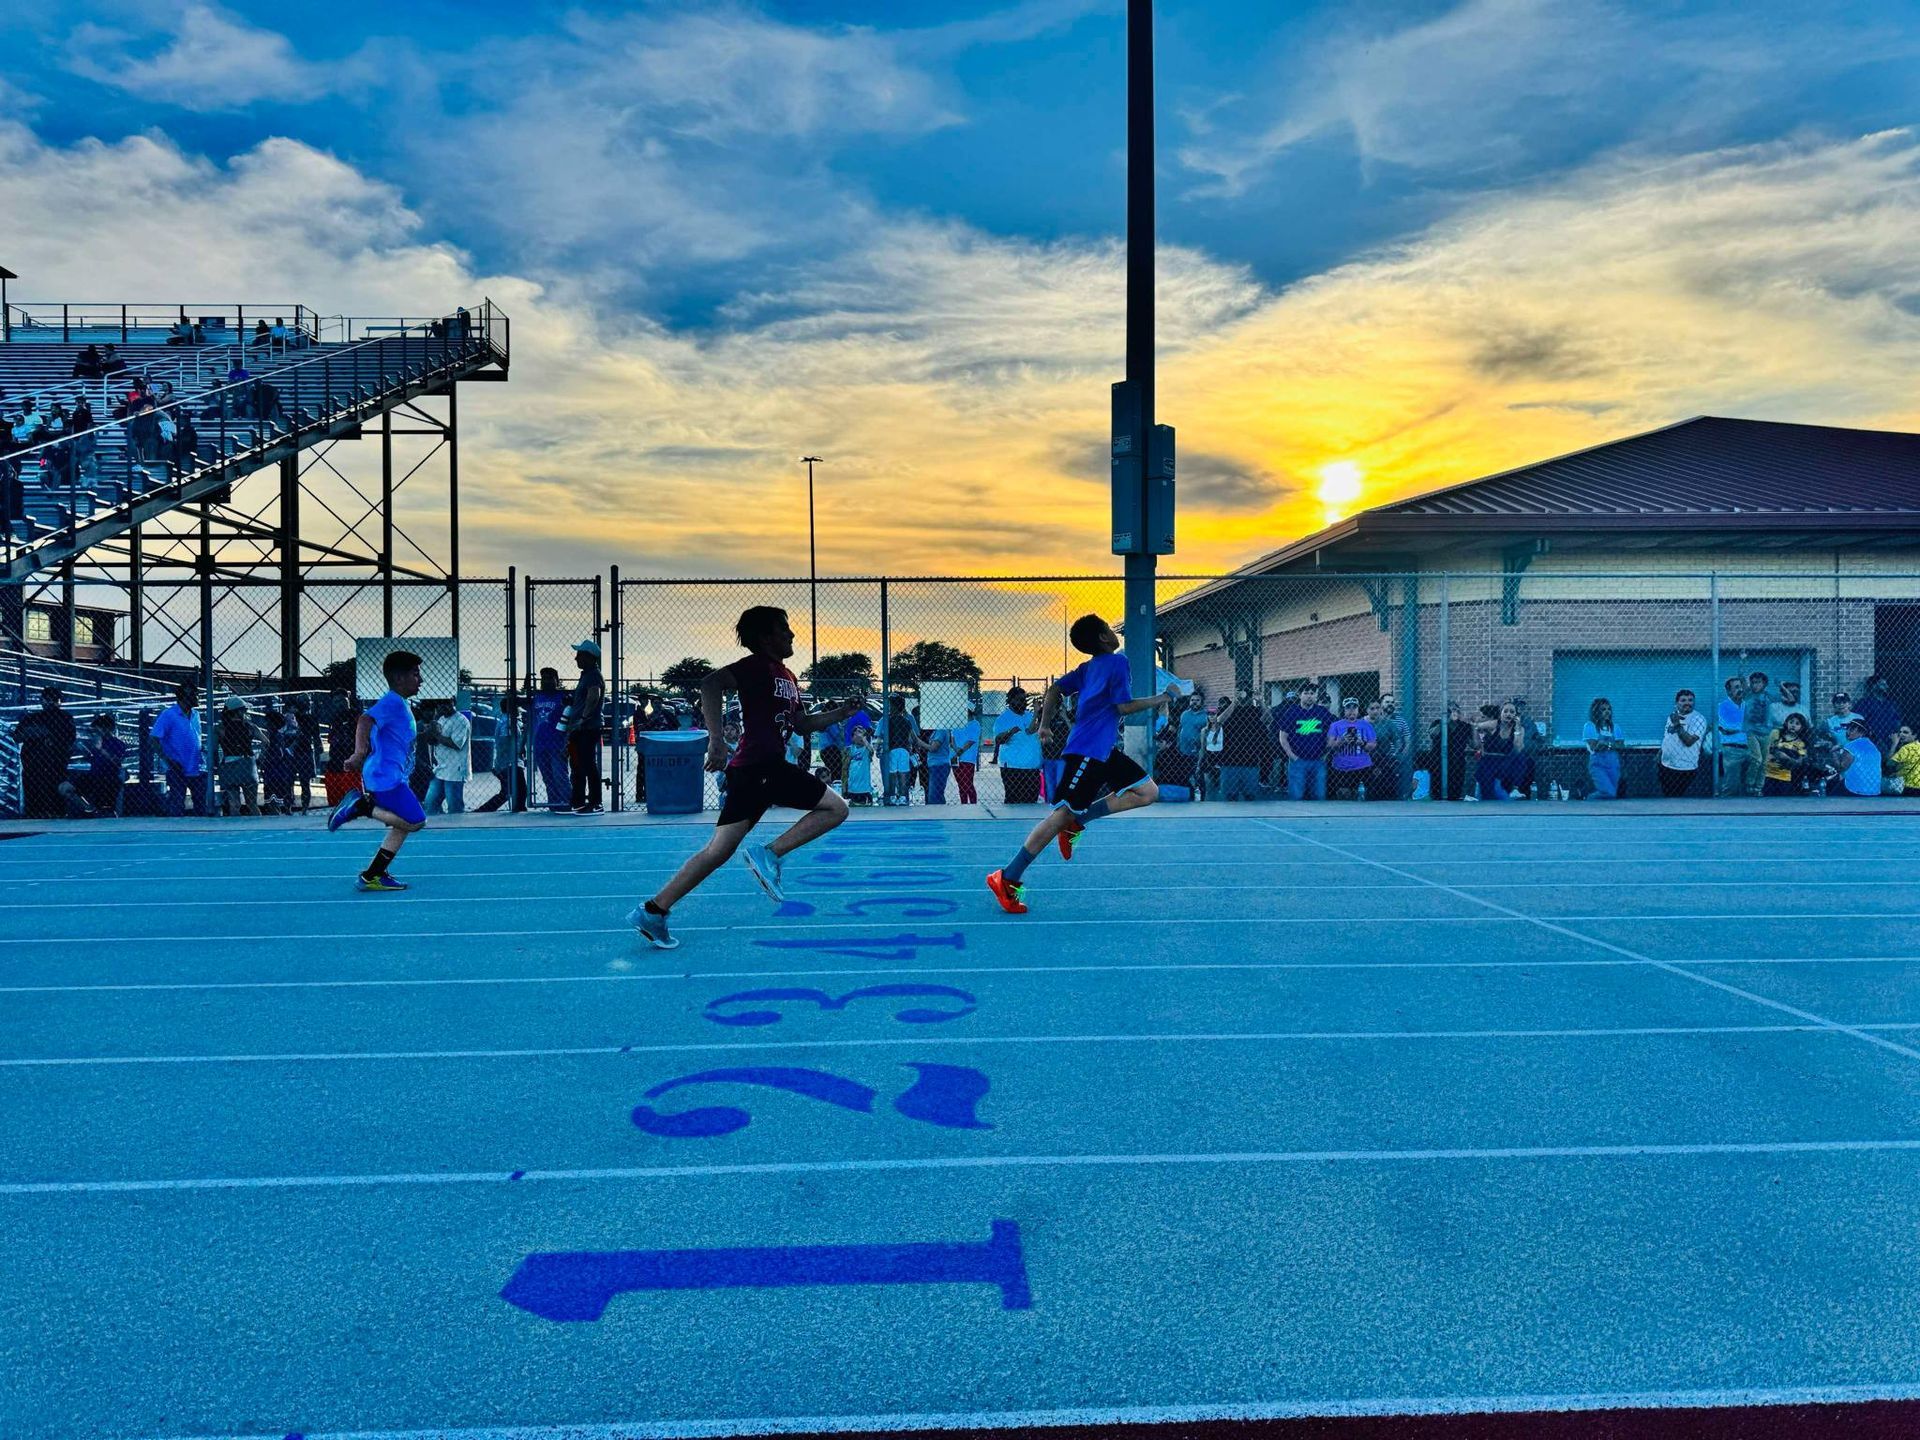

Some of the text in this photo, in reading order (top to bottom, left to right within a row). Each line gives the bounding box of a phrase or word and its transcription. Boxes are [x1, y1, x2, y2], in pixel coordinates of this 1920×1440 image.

[796, 870, 954, 887] 6
[772, 897, 959, 917] 5
[752, 932, 966, 960] 4
[703, 983, 977, 1027] 3
[631, 1062, 995, 1138] 2
[500, 1219, 1033, 1322] 1
